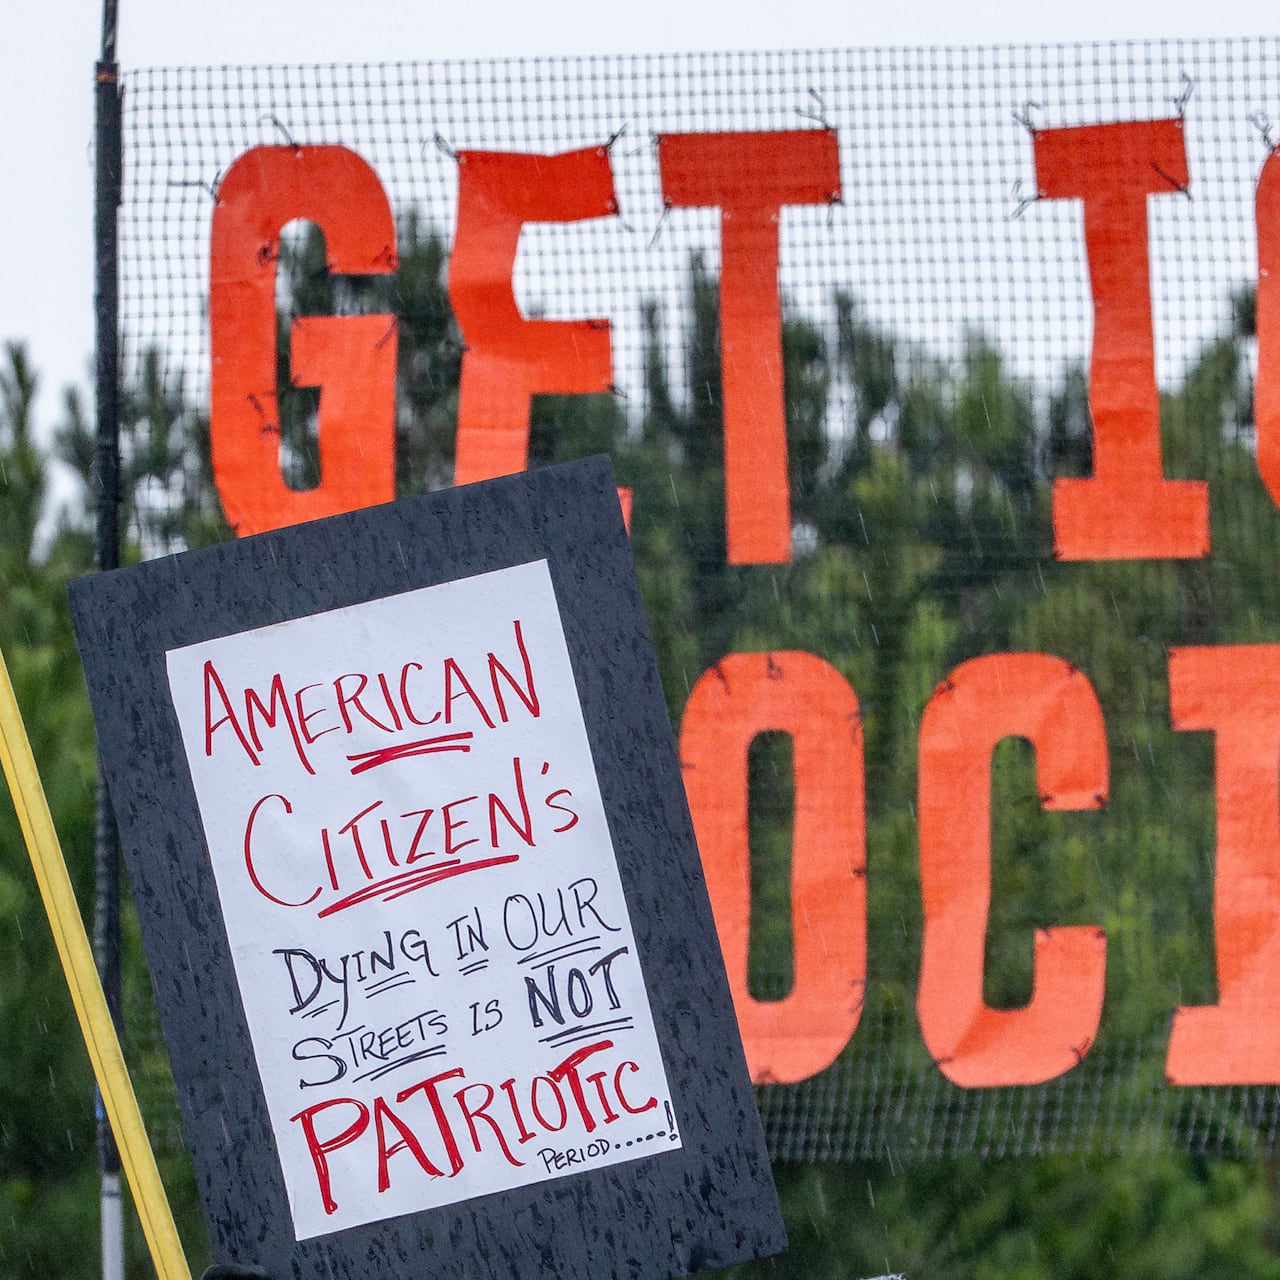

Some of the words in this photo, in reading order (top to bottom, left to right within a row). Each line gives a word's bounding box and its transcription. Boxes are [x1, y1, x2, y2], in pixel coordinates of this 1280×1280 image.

[209, 127, 841, 565] GET
[204, 620, 540, 775] AMERICAN
[272, 929, 440, 1031] DYING
[446, 907, 489, 960] IN
[504, 878, 622, 950] OUR
[292, 1009, 448, 1090] STREETS
[469, 1000, 503, 1036] IS
[524, 946, 629, 1028] NOT
[290, 1041, 658, 1215] PATRIOTIC
